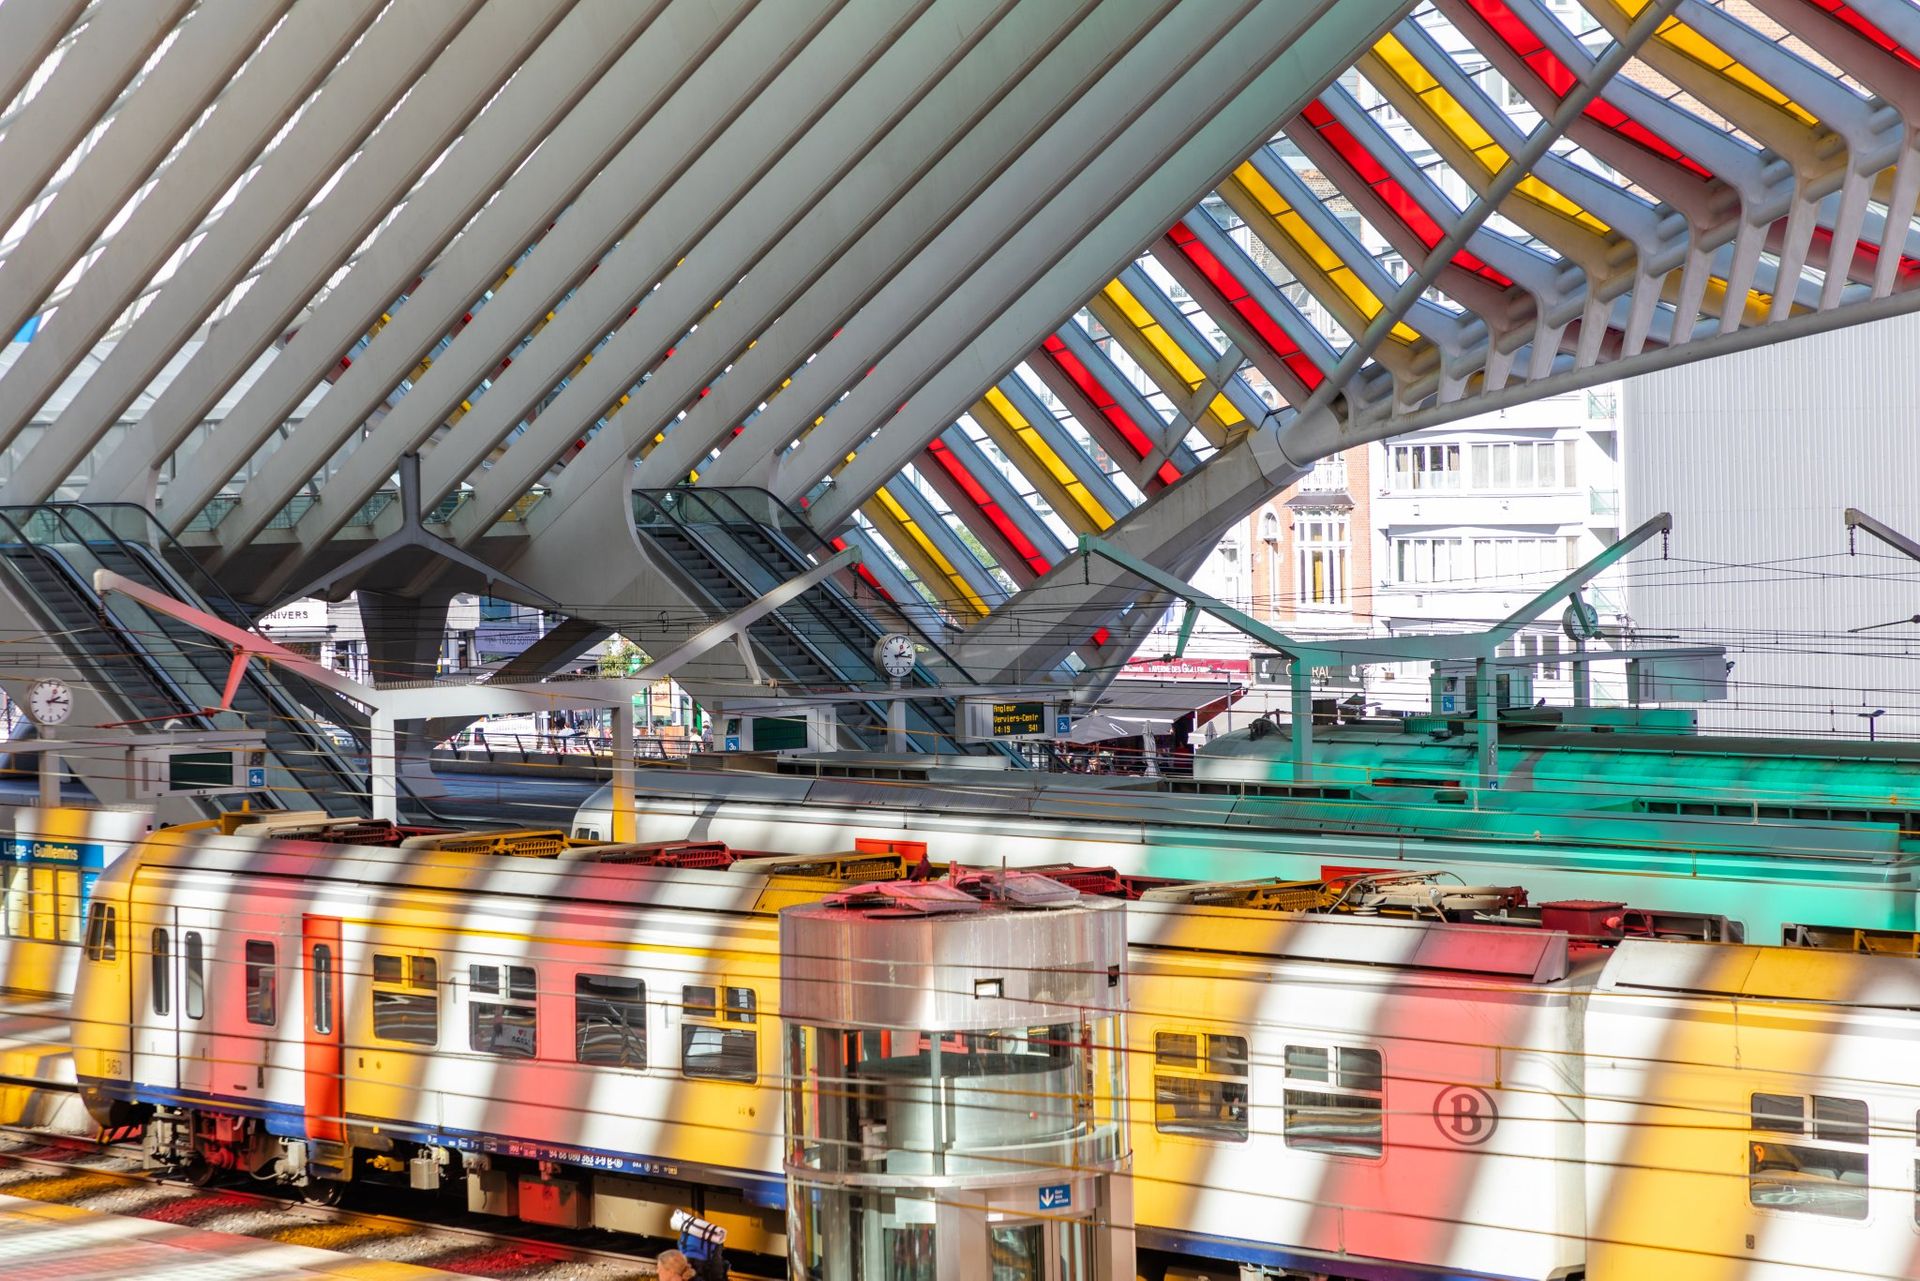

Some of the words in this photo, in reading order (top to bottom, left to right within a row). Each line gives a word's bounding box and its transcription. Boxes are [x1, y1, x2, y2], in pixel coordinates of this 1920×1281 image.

[994, 704, 1016, 713] Angleur
[995, 725, 1011, 733] 14:19
[3, 841, 26, 859] Liège
